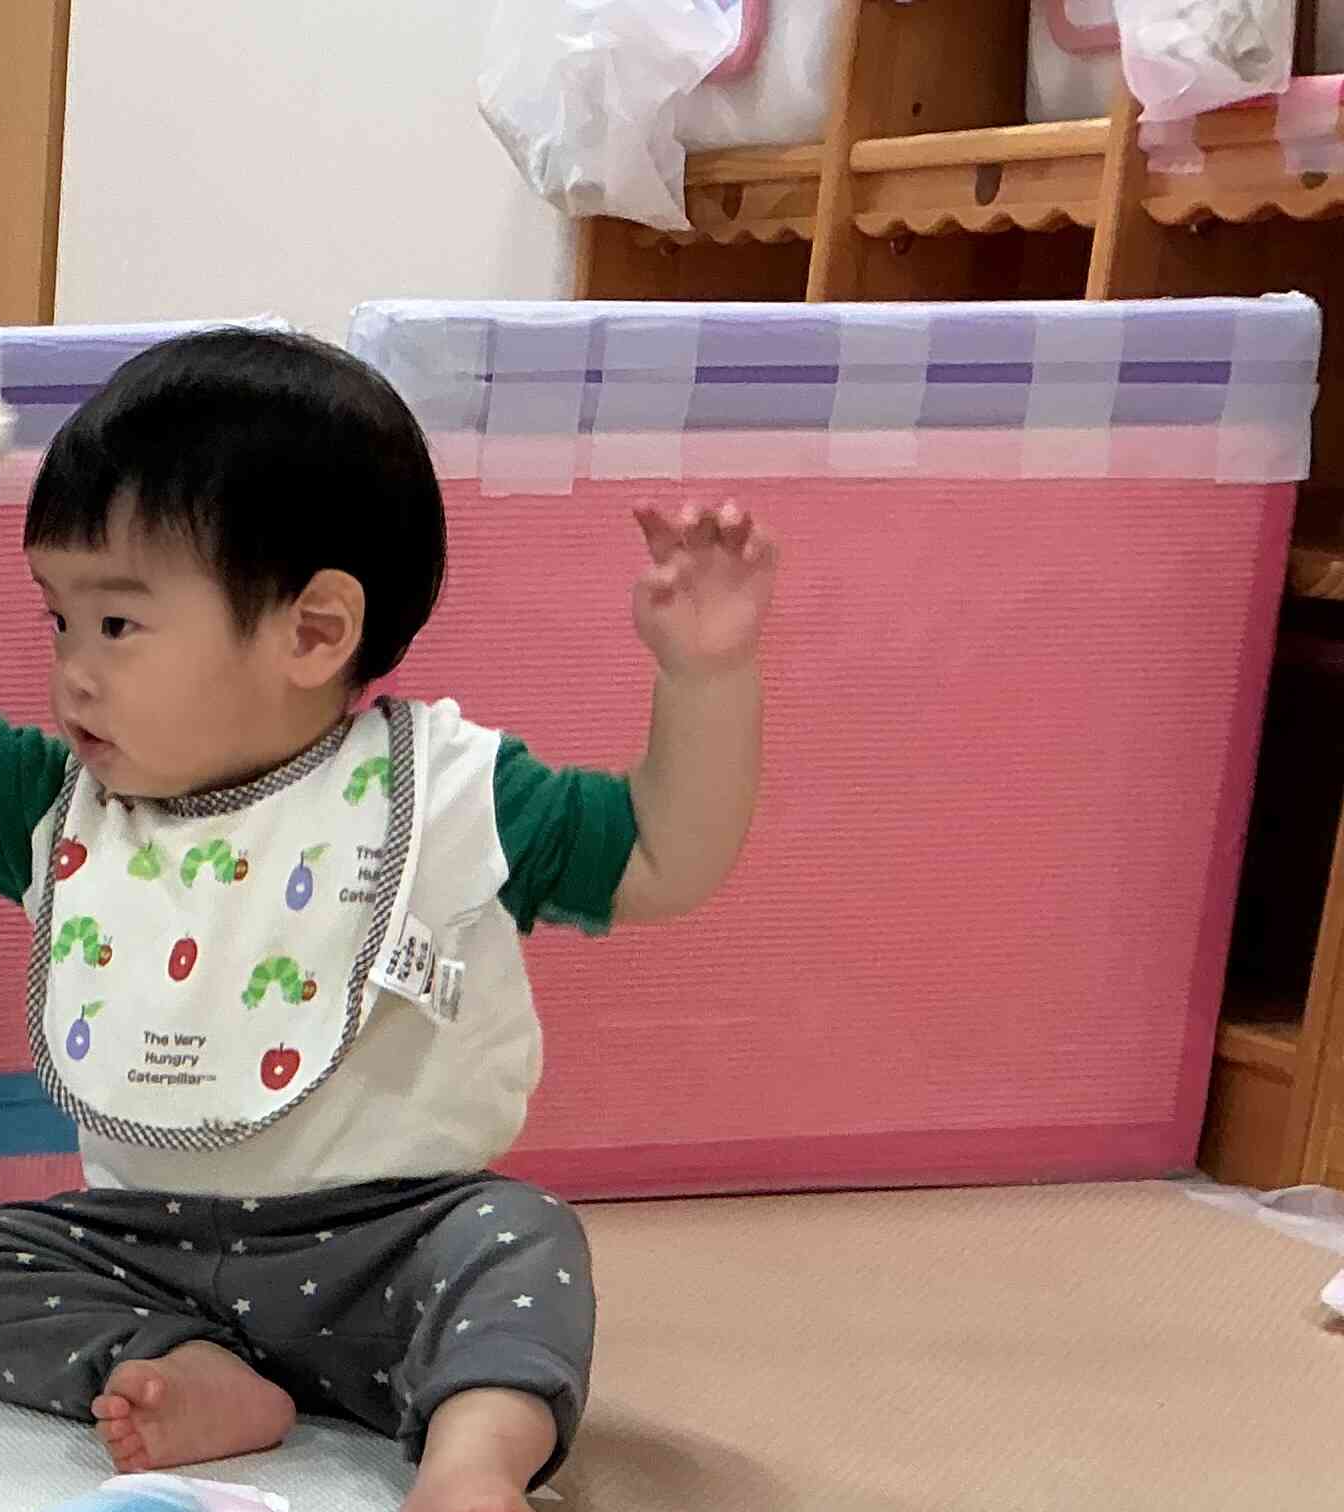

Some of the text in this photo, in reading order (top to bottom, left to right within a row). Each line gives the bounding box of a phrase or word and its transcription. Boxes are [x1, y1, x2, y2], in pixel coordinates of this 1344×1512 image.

[143, 1030, 207, 1049] The Very
[144, 1052, 200, 1067] Hungry
